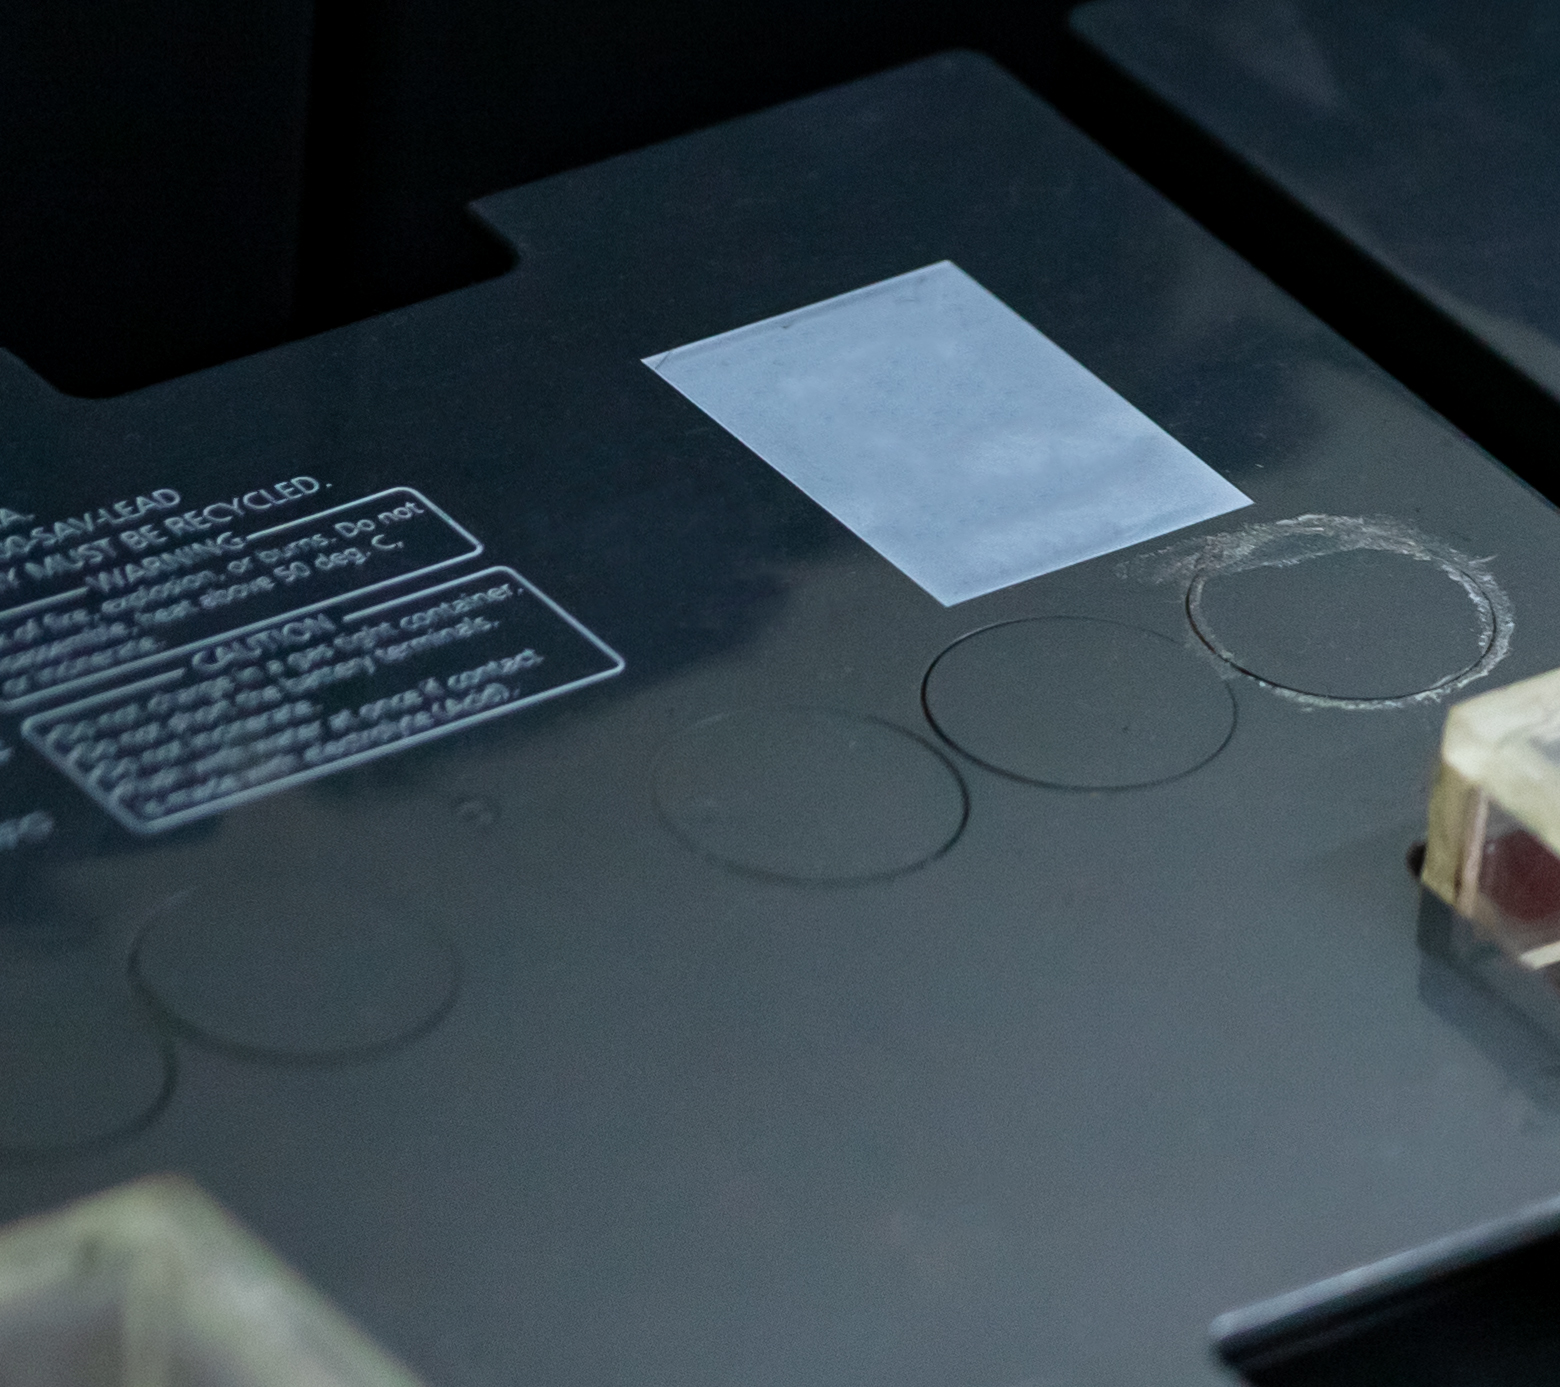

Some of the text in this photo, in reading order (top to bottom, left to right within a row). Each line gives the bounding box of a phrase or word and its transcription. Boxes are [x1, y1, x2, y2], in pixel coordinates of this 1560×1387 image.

[119, 524, 168, 550] BE
[165, 476, 332, 535] RECYCLED.
[334, 519, 376, 538] Do
[377, 501, 425, 527] not
[85, 531, 245, 593] WARNING
[273, 561, 311, 583] 50
